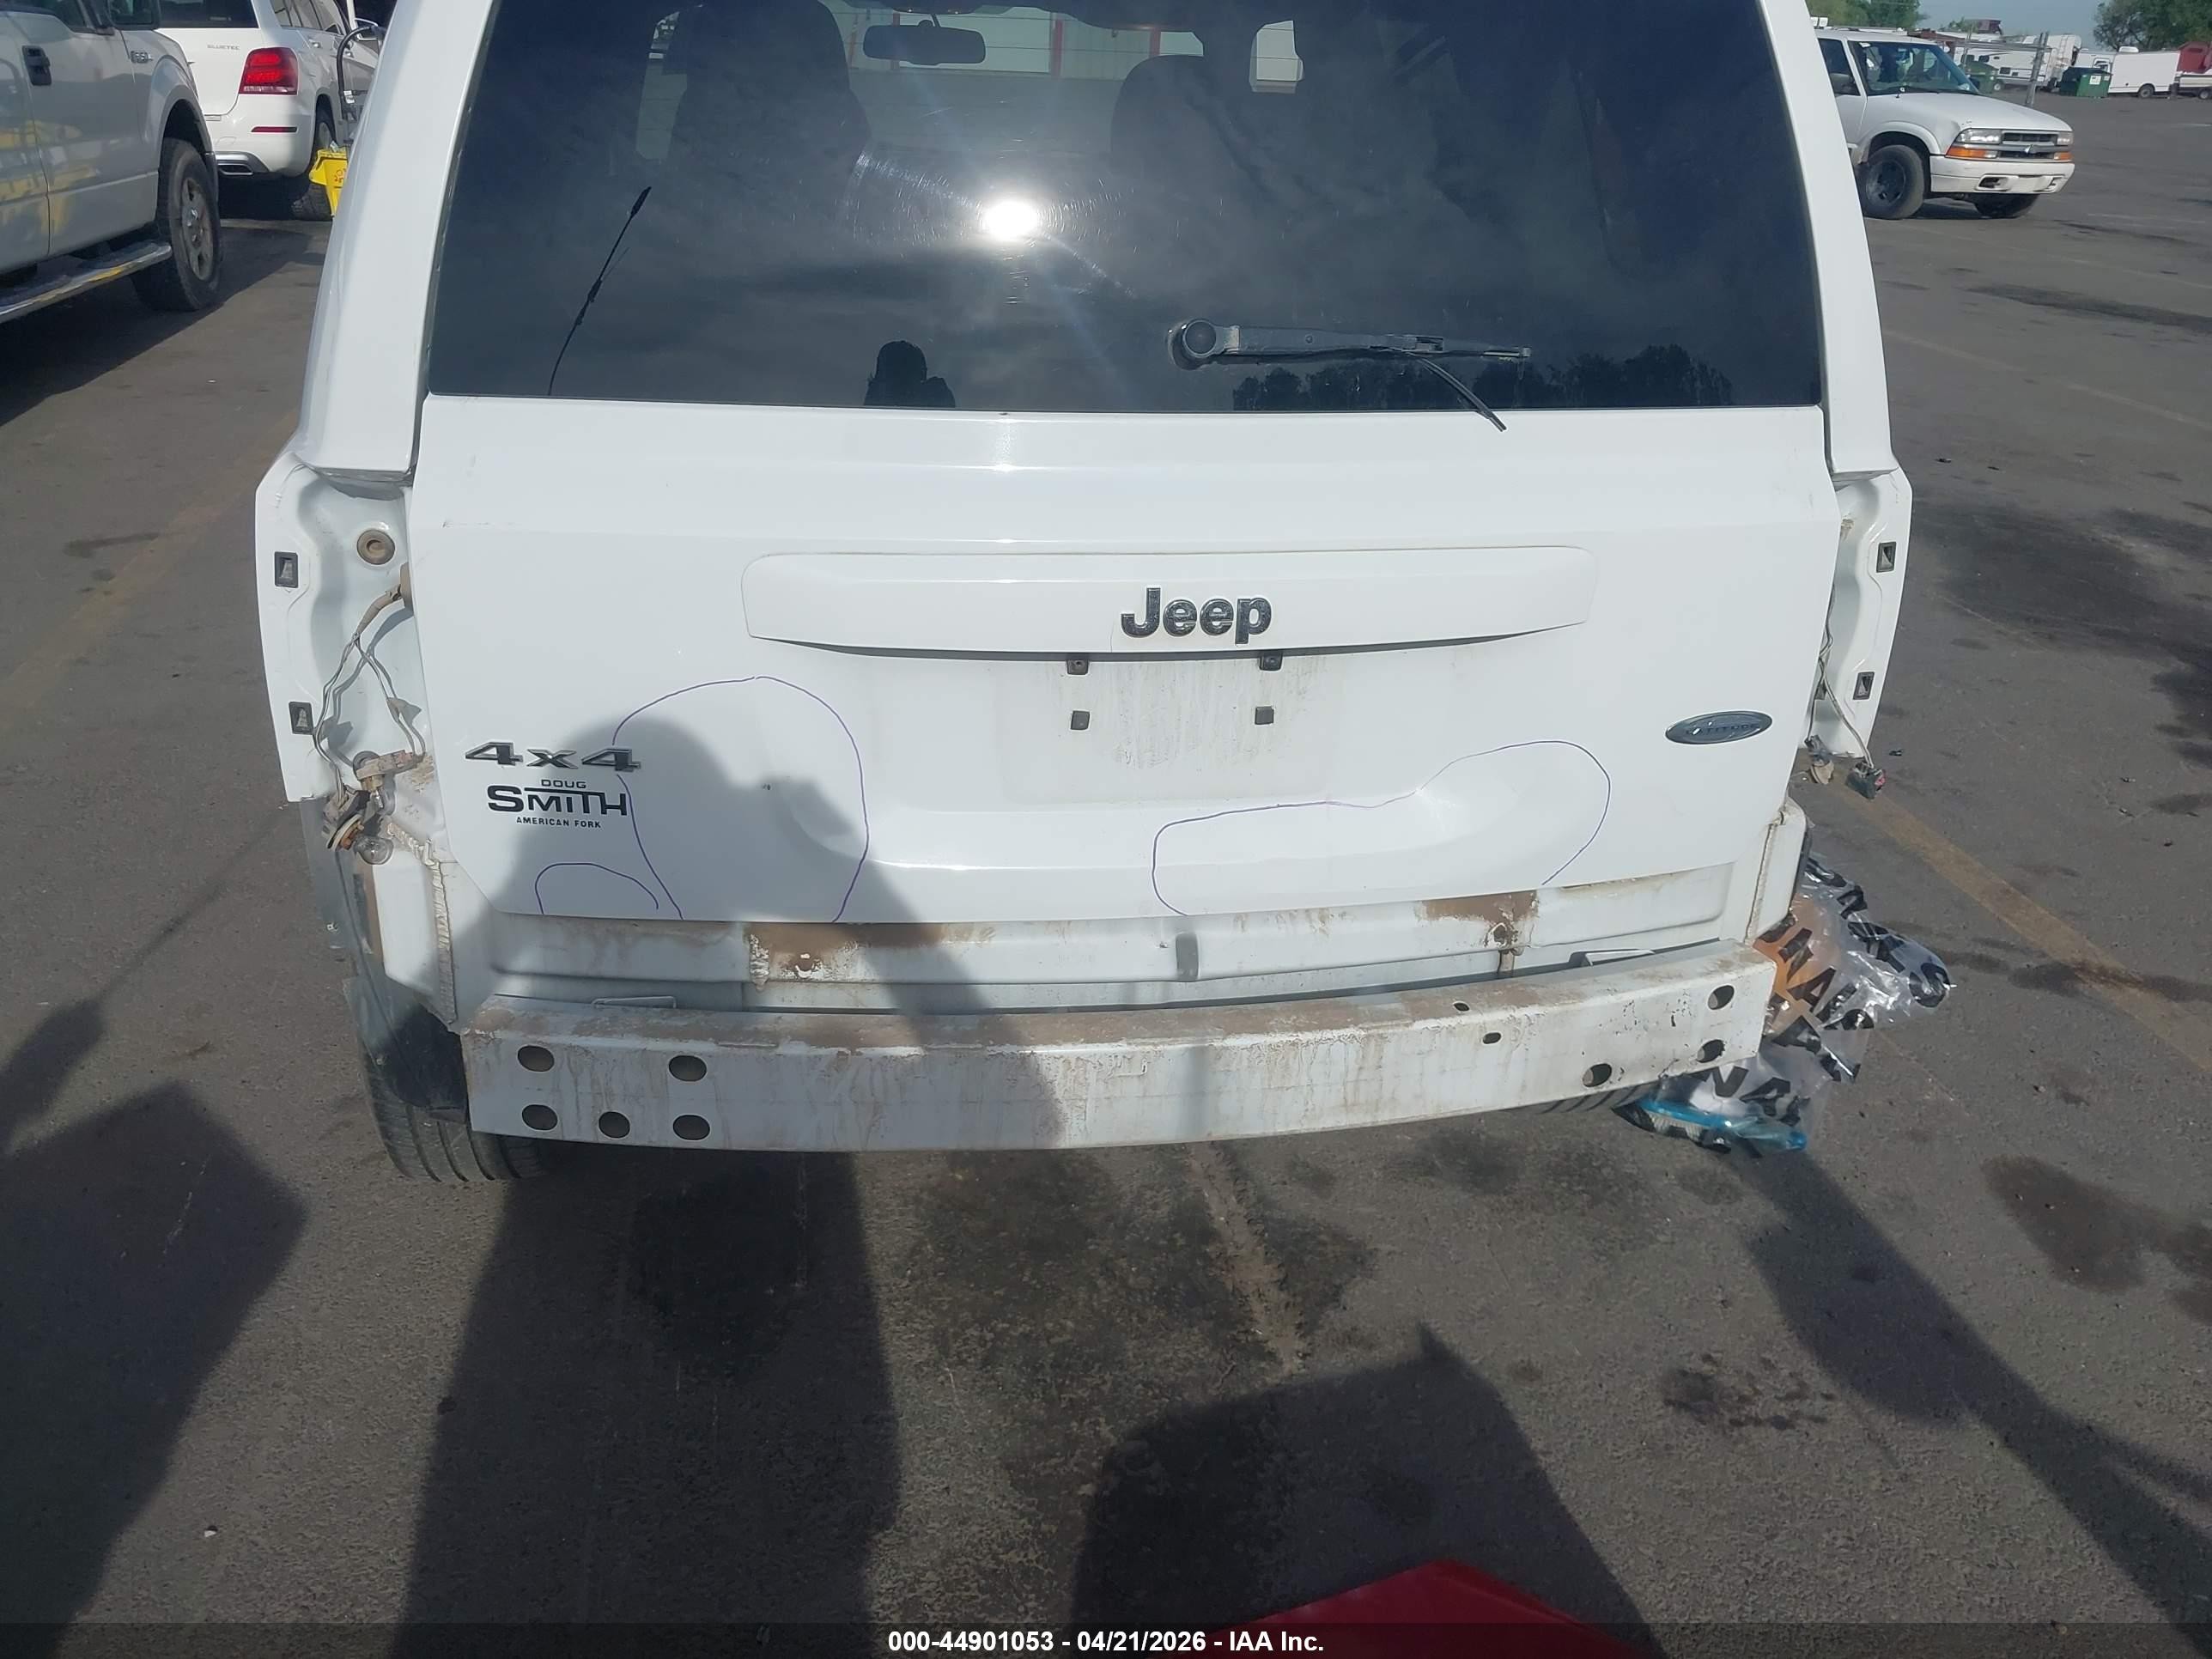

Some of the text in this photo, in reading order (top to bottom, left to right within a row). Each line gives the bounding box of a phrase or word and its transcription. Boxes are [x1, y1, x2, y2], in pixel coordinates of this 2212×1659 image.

[1121, 587, 1272, 645] Jeep
[541, 779, 586, 789] DOUG
[487, 784, 628, 816] SMITH
[516, 816, 601, 829] AMERICAN FORK
